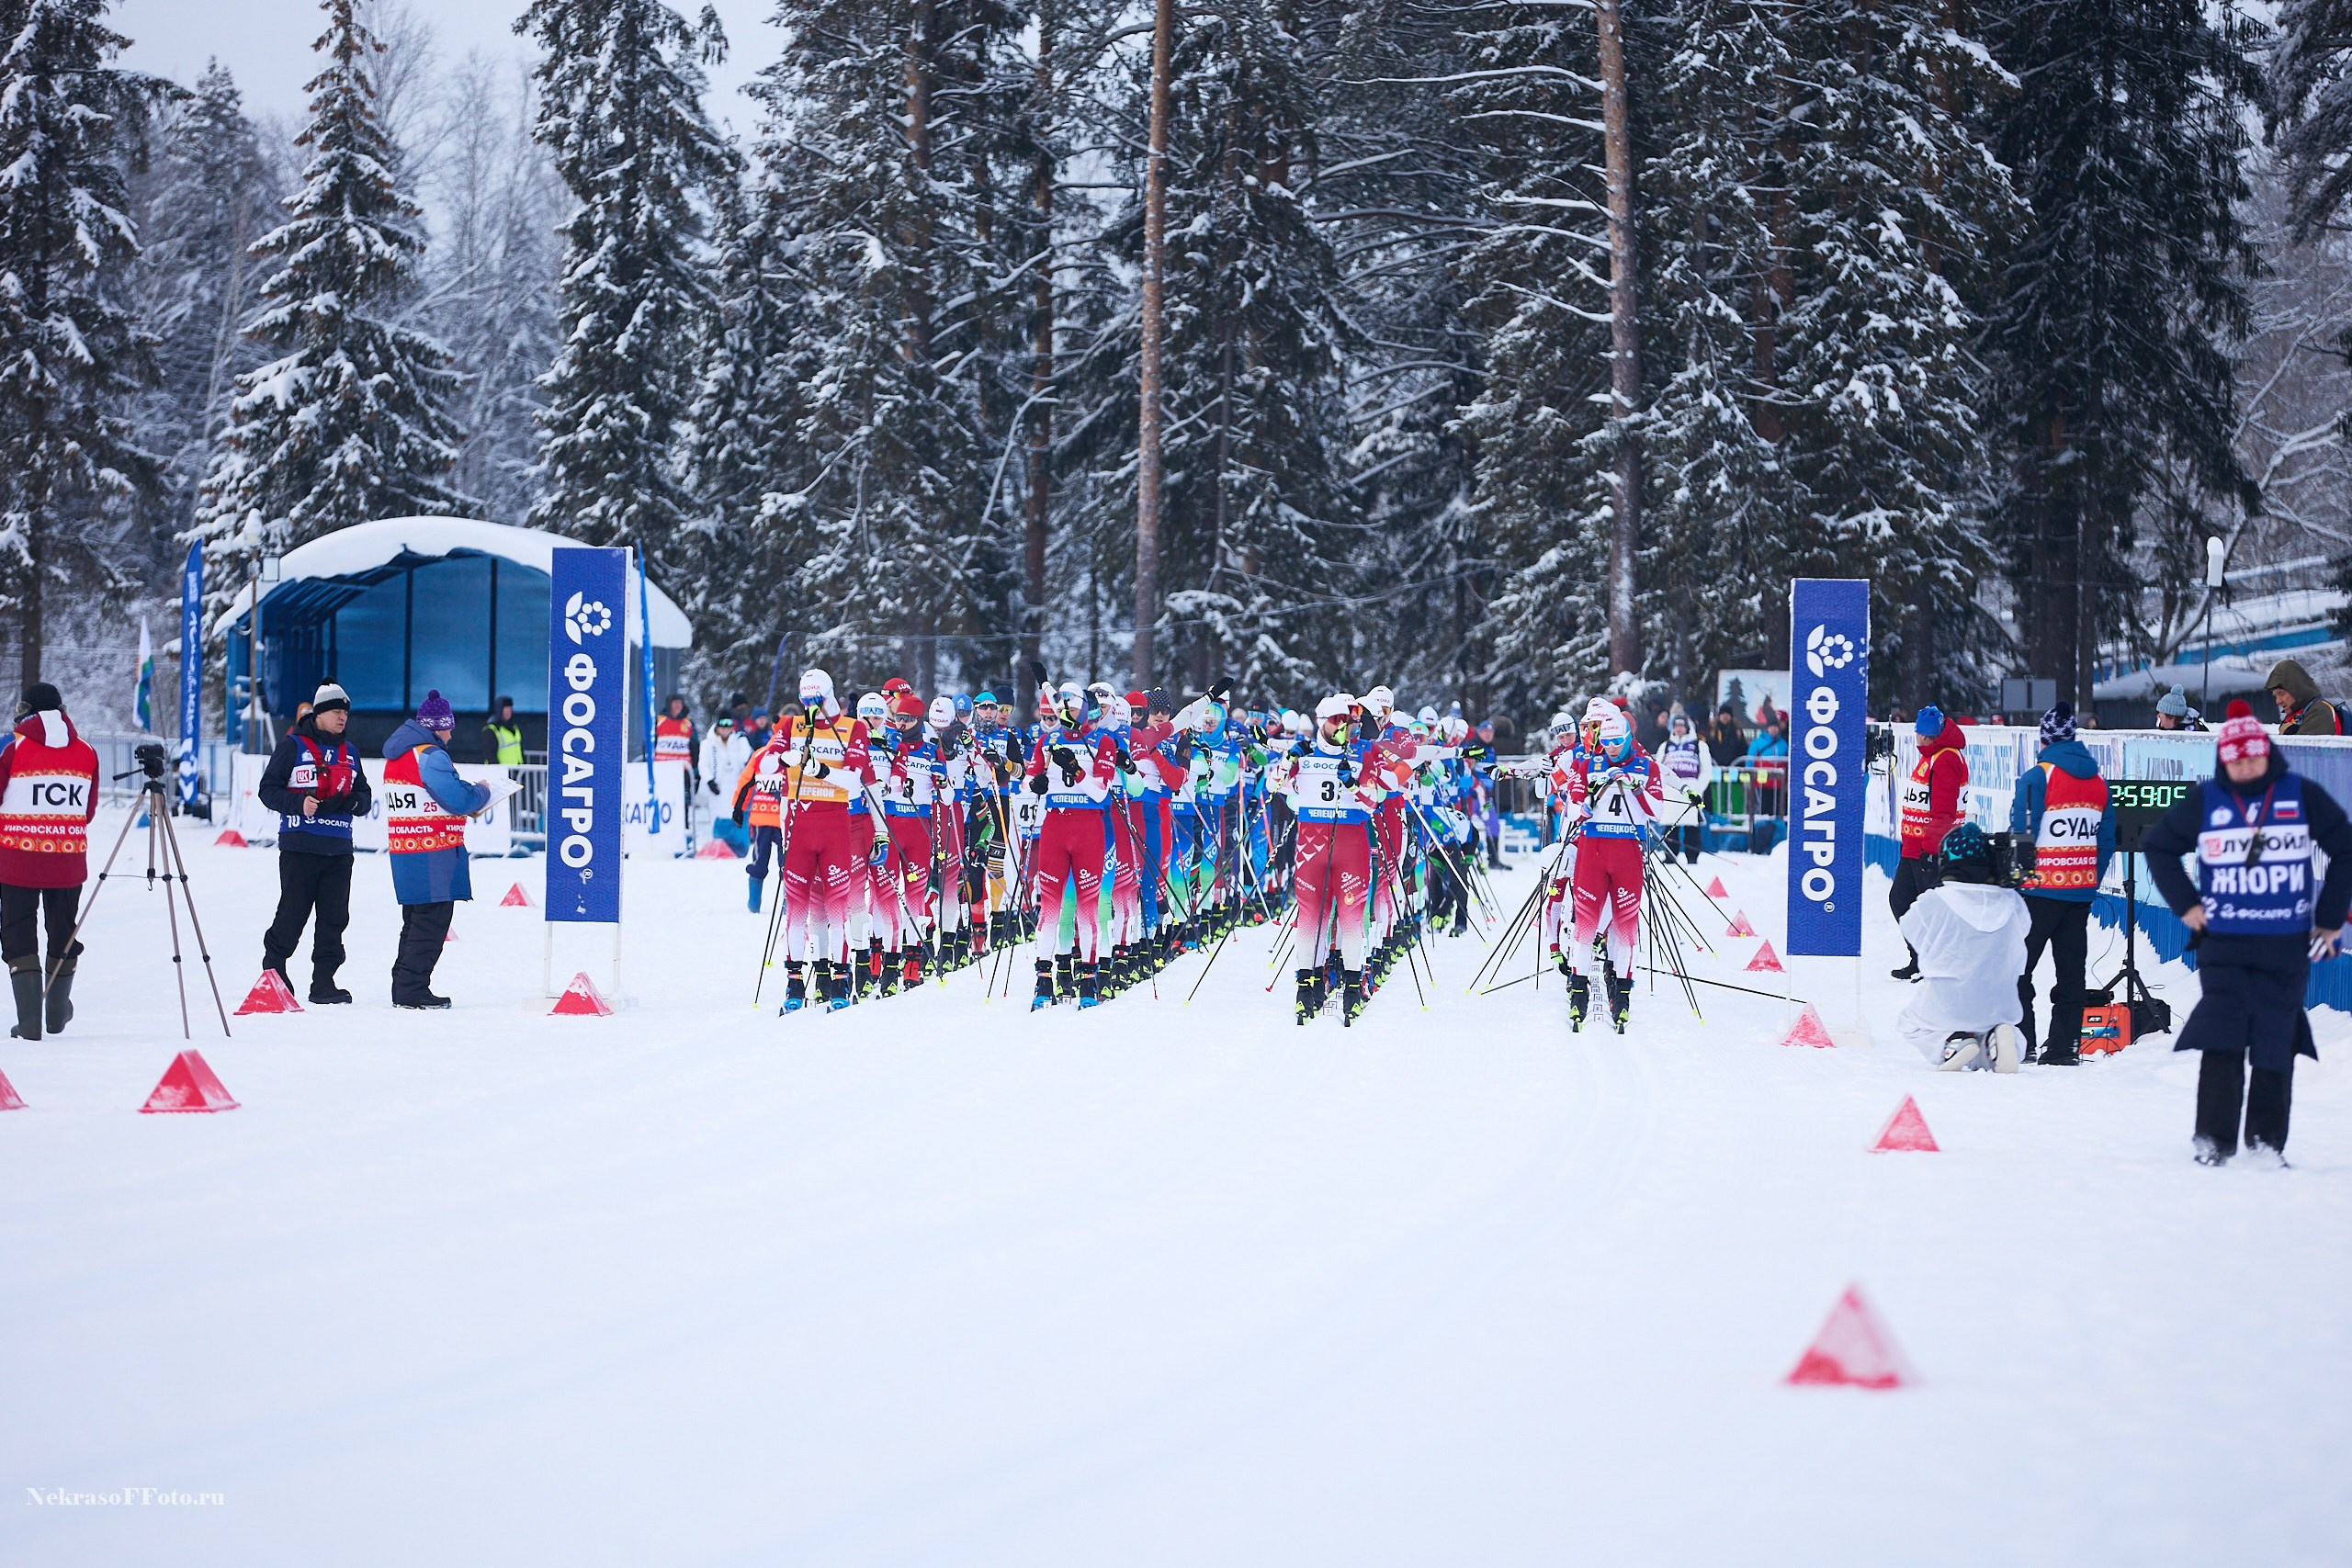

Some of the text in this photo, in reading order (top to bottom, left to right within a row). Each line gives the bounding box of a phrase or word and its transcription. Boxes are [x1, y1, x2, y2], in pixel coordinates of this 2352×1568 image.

[560, 653, 597, 868] ФОСАГРО
[32, 783, 84, 807] ГСК
[1051, 795, 1089, 805] ЧЕПЕЦКОЕ
[1321, 781, 1335, 801] 3
[1801, 686, 1839, 901] ФОСАГРО
[386, 792, 416, 811] ДЬЯ
[424, 802, 437, 813] 25
[1608, 794, 1622, 817] 4
[317, 818, 349, 829] ФОСАГРО
[1596, 824, 1635, 834] ЧЕПЕЦКОЕ
[2211, 863, 2304, 895] ЖЮРИ
[2236, 907, 2292, 919] ФОСАГРО
